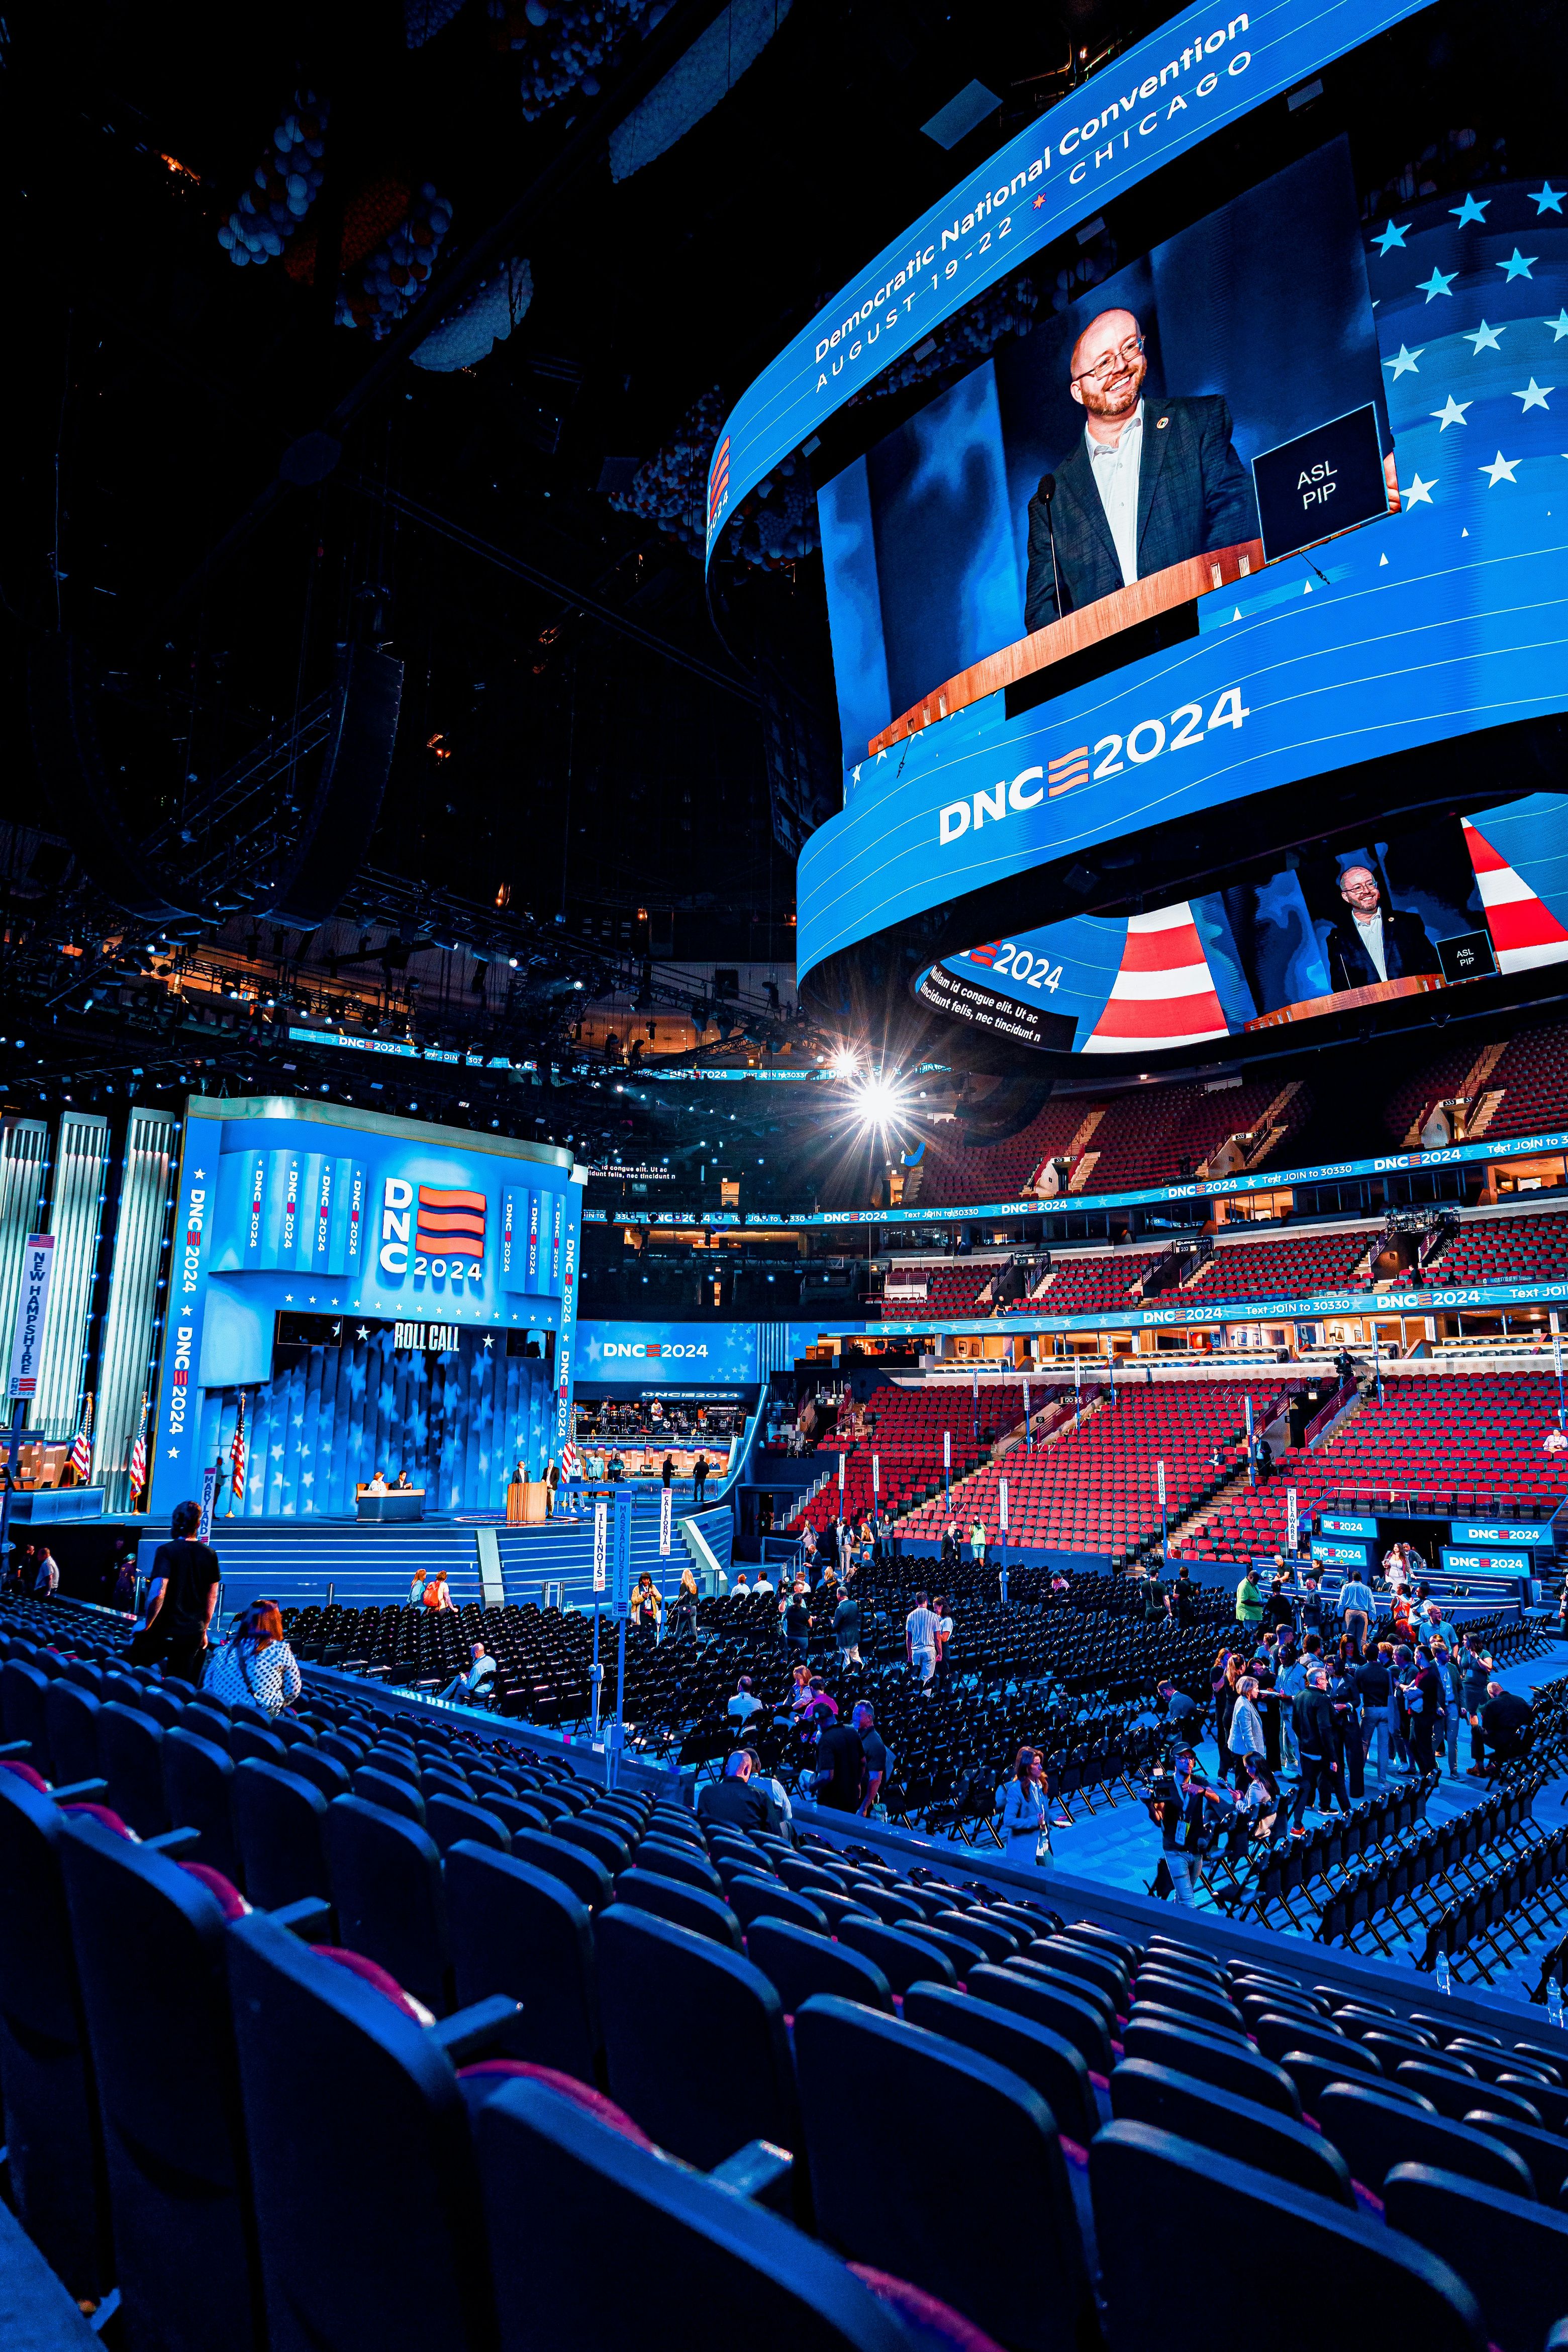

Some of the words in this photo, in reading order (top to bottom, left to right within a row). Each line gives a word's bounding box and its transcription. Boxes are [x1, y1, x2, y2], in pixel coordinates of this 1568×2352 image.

[815, 239, 935, 364] Democratic
[940, 146, 1051, 252] National
[1059, 13, 1250, 155] Convention
[815, 291, 918, 393] AUGUST
[931, 217, 1014, 289] 19-22
[1068, 50, 1253, 185] CHICAGO
[1297, 460, 1337, 489] ASL
[1303, 482, 1336, 510] PIP
[939, 766, 1044, 846] DNC
[1092, 687, 1250, 780] 2024
[993, 943, 1063, 994] 2024
[1457, 948, 1474, 958] ASL
[1459, 956, 1475, 966] PIP
[930, 965, 950, 989] Nullam
[950, 980, 961, 994] id
[960, 988, 995, 1007] congue
[996, 1001, 1013, 1014] elit.
[1015, 1007, 1026, 1019] Ut
[1026, 1014, 1038, 1024] ac
[920, 981, 951, 1009] tincidunt
[951, 1001, 973, 1020] felis,
[975, 1011, 993, 1025] nec
[995, 1017, 1034, 1040] tincidunt
[1034, 1033, 1041, 1042] n
[339, 1037, 365, 1048] DNC
[373, 1042, 402, 1053] 2024
[1374, 1156, 1409, 1170] DNC
[1421, 1149, 1461, 1164] 2024
[1487, 1144, 1510, 1153] Text
[1514, 1138, 1543, 1150] JOIN
[1546, 1137, 1558, 1146] to
[253, 1170, 263, 1201] DNC
[287, 1170, 298, 1203] DNC
[1168, 1186, 1196, 1198] DNC
[1206, 1180, 1237, 1193] 2024
[1262, 1175, 1282, 1184] Text
[1284, 1171, 1306, 1182] JOIN
[1321, 1165, 1352, 1176] 30330
[321, 1175, 331, 1207] DNC
[352, 1180, 361, 1212] DNC
[188, 1189, 206, 1231] DNC
[824, 1213, 849, 1222] DNC
[859, 1212, 888, 1221] 2024
[953, 1208, 978, 1216] 30330
[1002, 1204, 1028, 1214] DNC
[1037, 1200, 1067, 1211] 2024
[249, 1213, 259, 1248] 2024
[283, 1213, 294, 1249] 2024
[317, 1217, 327, 1252] 2024
[349, 1222, 358, 1255] 2024
[30, 1251, 46, 1282] NEW
[182, 1246, 200, 1293] 2024
[414, 1256, 482, 1281] 2024
[565, 1240, 575, 1273] DNC
[563, 1286, 572, 1324] 2024
[1245, 1306, 1267, 1315] Text
[1269, 1304, 1296, 1314] JOIN
[1299, 1303, 1310, 1311] to
[1314, 1300, 1350, 1311] 30330
[1377, 1294, 1418, 1309] DNC
[1433, 1291, 1481, 1305] 2024
[1509, 1288, 1539, 1299] Text
[20, 1285, 40, 1375] HAMPSHIRE
[1143, 1310, 1174, 1323] DNC
[1186, 1307, 1222, 1321] 2024
[174, 1327, 192, 1369] DNC
[394, 1322, 428, 1350] ROLL
[429, 1325, 460, 1352] CALL
[604, 1343, 645, 1357] DNC
[662, 1344, 709, 1357] 2024
[560, 1351, 569, 1386] DNC
[169, 1386, 187, 1435] 2024
[558, 1398, 567, 1437] 2024
[200, 1475, 214, 1535] MARYLAND
[1323, 1520, 1334, 1530] DNC
[1340, 1522, 1363, 1532] 2024
[1468, 1528, 1499, 1539] DNC
[1509, 1530, 1540, 1540] 2024
[618, 1505, 627, 1599] MASSACHUSETTS
[1313, 1546, 1328, 1555] DNC
[1335, 1548, 1361, 1559] 2024
[1449, 1556, 1480, 1567] DNC
[1489, 1558, 1523, 1569] 2024
